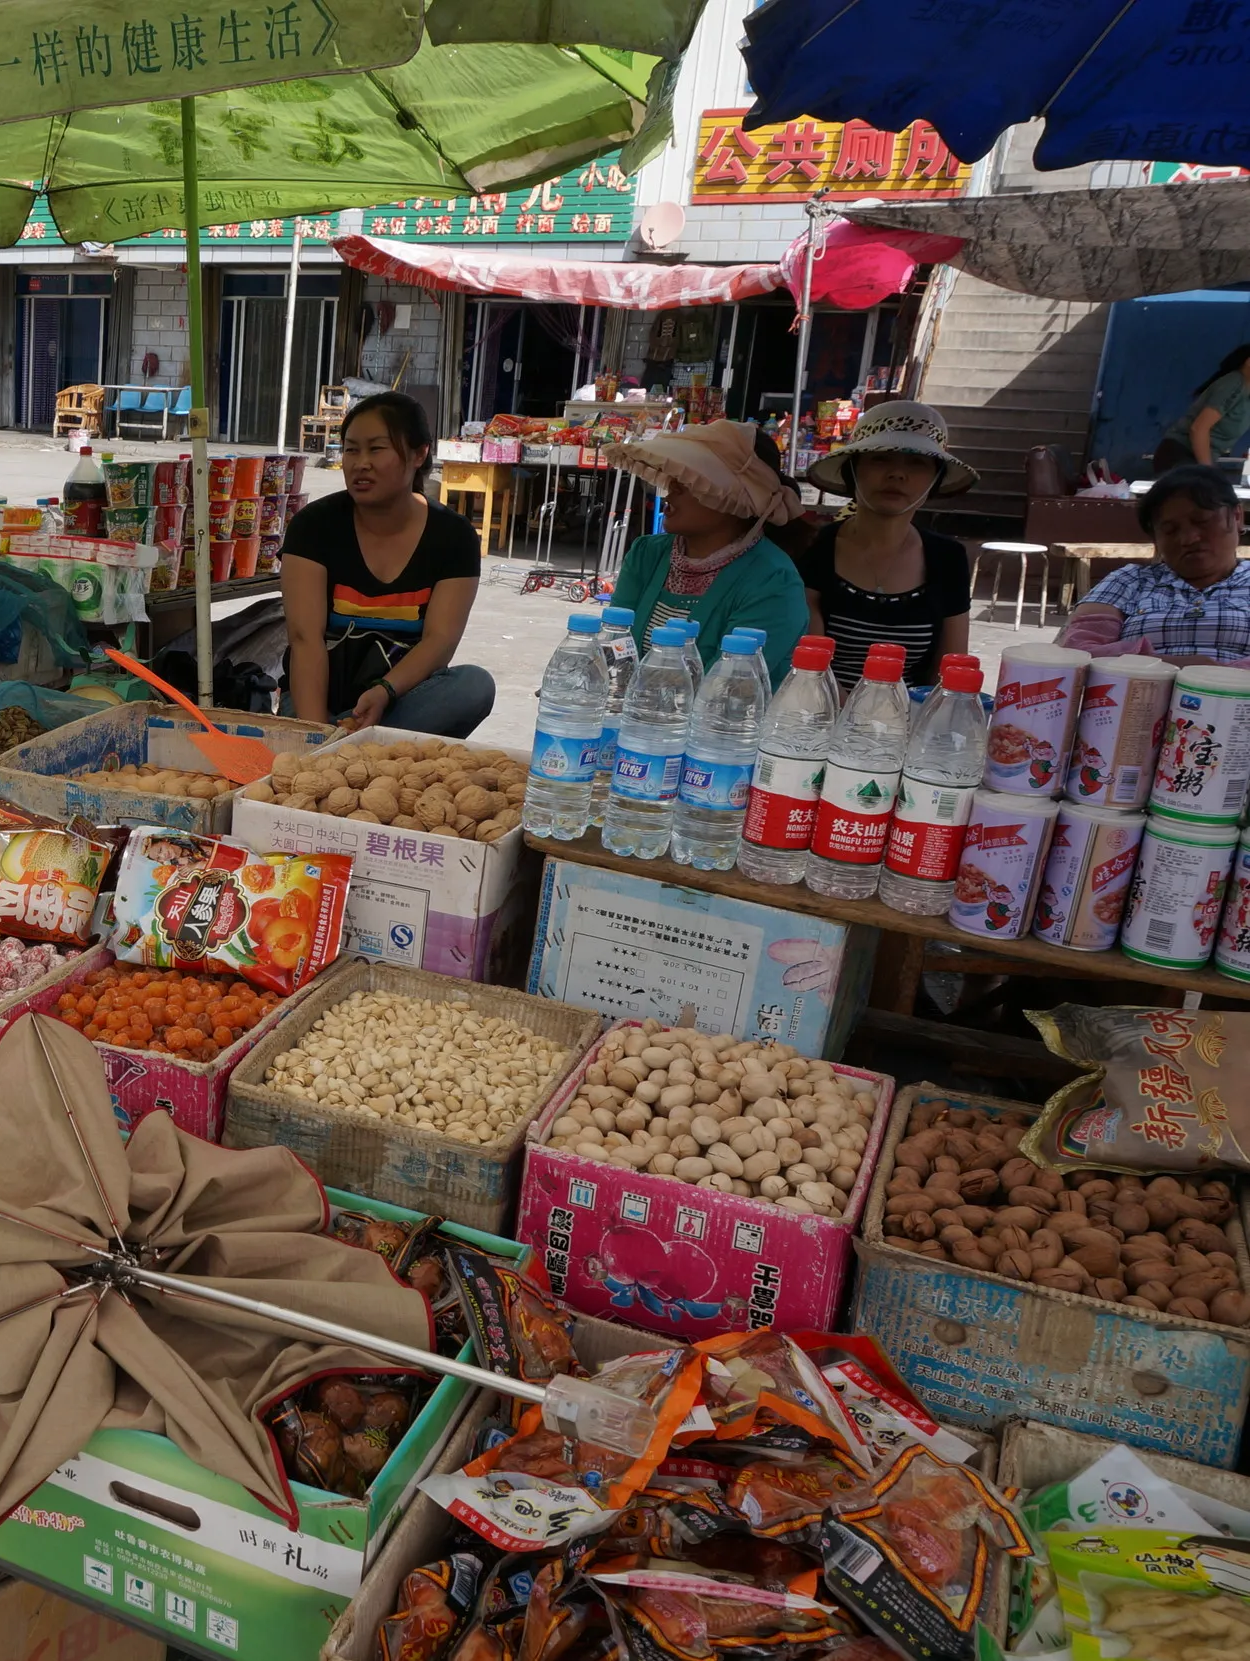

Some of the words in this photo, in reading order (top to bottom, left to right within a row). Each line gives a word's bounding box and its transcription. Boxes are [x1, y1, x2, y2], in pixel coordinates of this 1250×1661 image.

[700, 118, 961, 185] 公共厕所
[578, 162, 631, 192] 小吃
[250, 218, 285, 238] 炒菜
[371, 217, 407, 236] 米饭
[415, 216, 453, 236] 炒菜
[462, 215, 500, 235] 炒面
[516, 215, 556, 234] 拌面
[571, 213, 613, 234] 烩面
[273, 819, 296, 835] 大尖
[316, 827, 341, 843] 中尖
[830, 833, 861, 846] NONGFU
[832, 818, 887, 838] 农夫山泉
[271, 836, 295, 852] 大圆
[365, 831, 446, 868] 碧根果
[167, 890, 192, 921] 天山
[184, 884, 222, 939] 人参果
[1131, 1008, 1198, 1150] 新疆风味
[238, 1528, 330, 1581] 时鲜礼品
